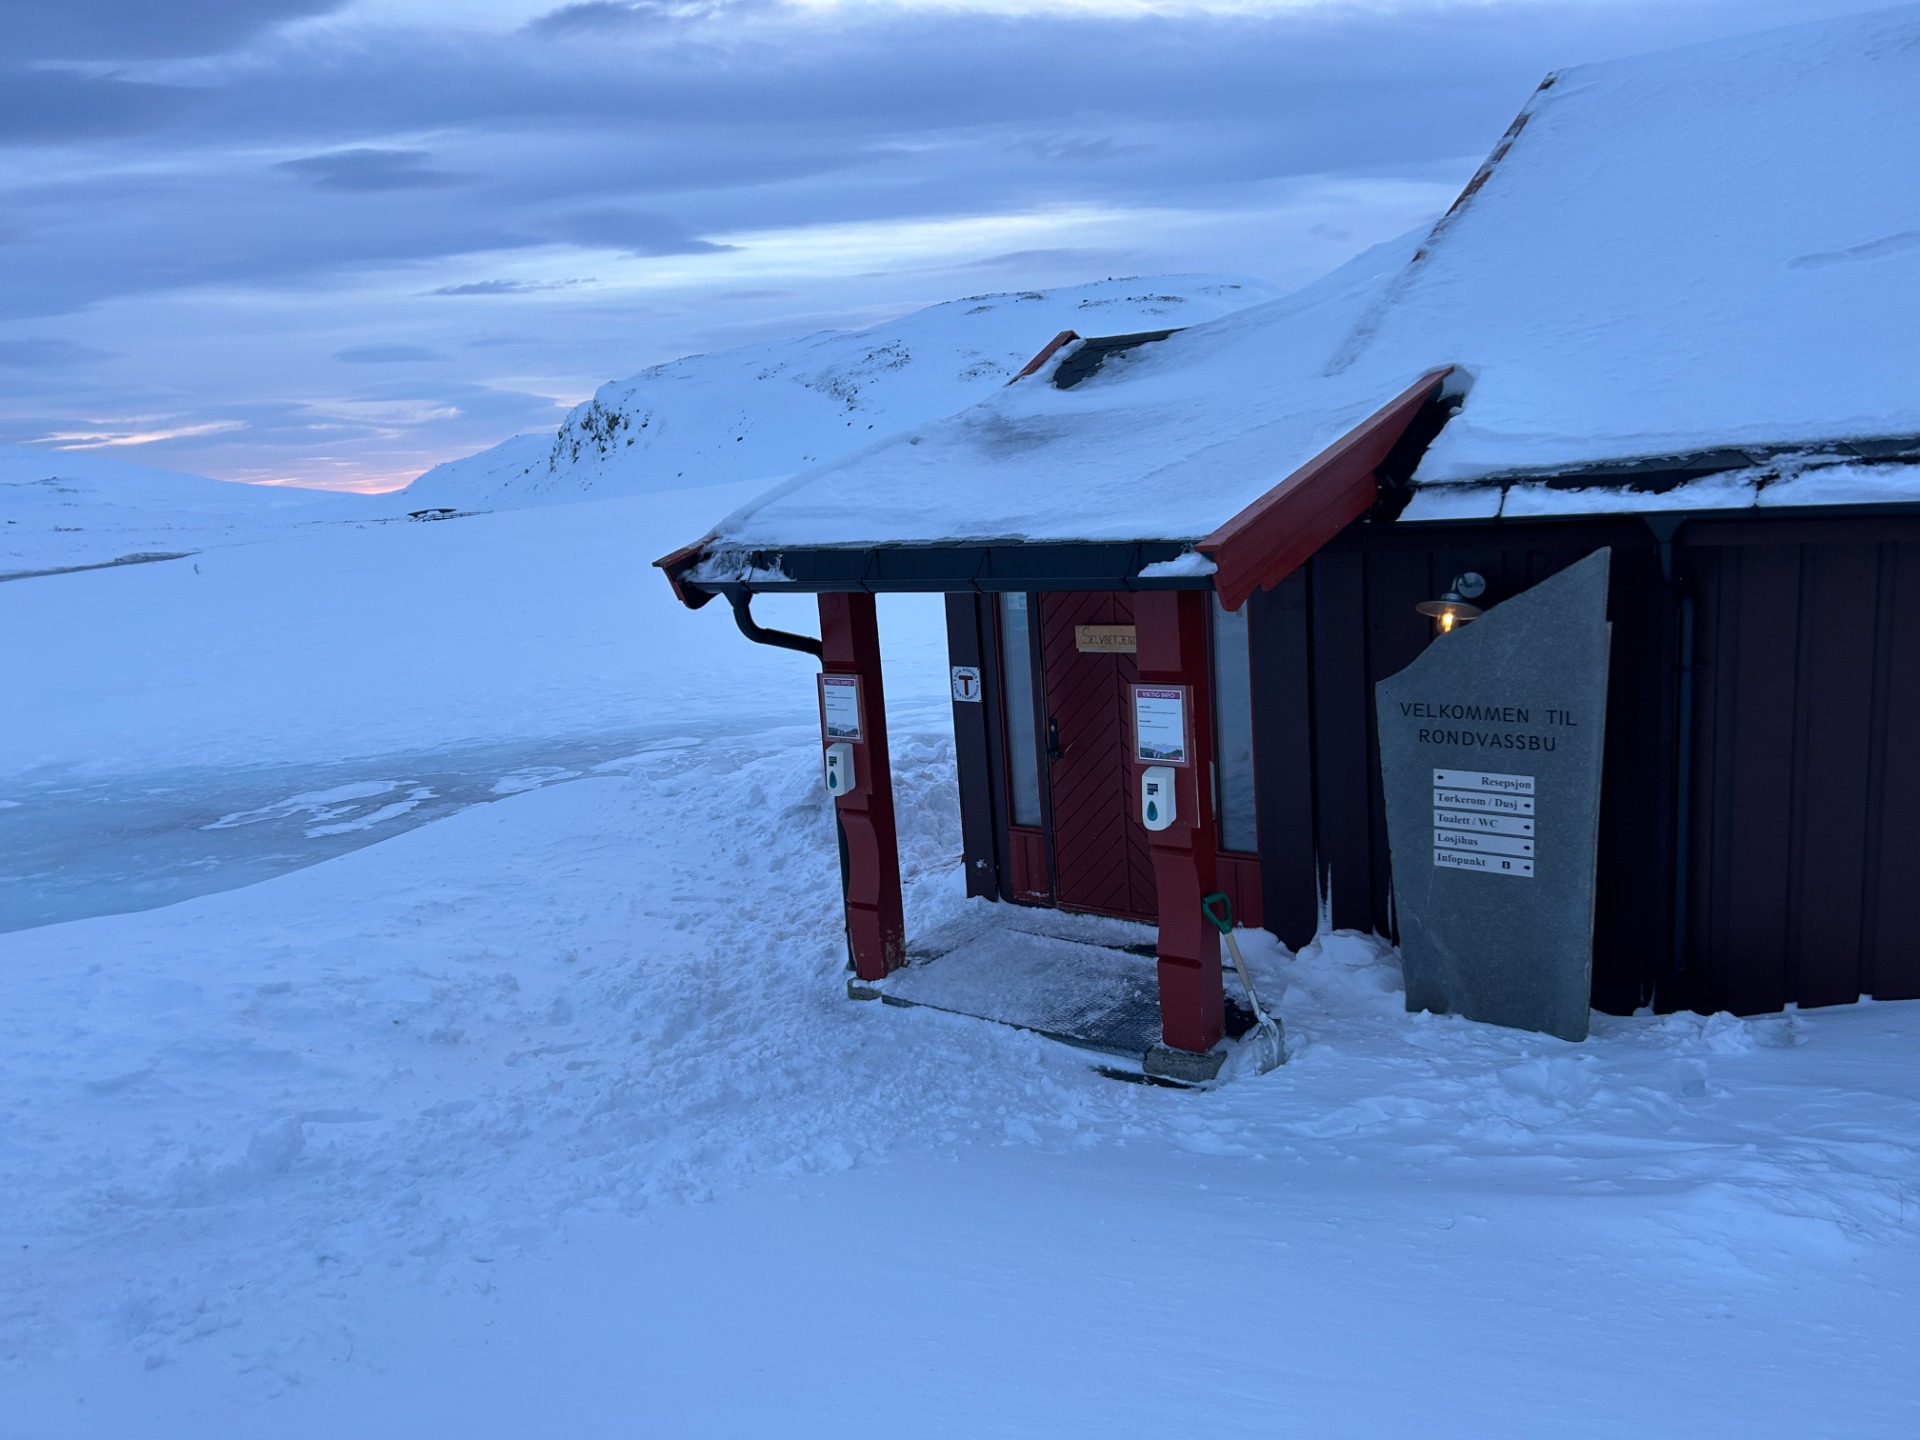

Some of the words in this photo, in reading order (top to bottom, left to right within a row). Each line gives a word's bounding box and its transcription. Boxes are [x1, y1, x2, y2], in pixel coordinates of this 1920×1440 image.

[1400, 702, 1529, 723] VELKOMMEN
[1546, 709, 1578, 726] TIL
[1419, 729, 1556, 751] RONDVASSBU
[1481, 776, 1532, 790] Resepsjon
[1494, 798, 1518, 811] Dusj
[1437, 813, 1471, 826] Toalett
[1479, 817, 1498, 829] WC
[1437, 832, 1479, 847] Losjihus
[1437, 852, 1486, 868] Infopunkt
